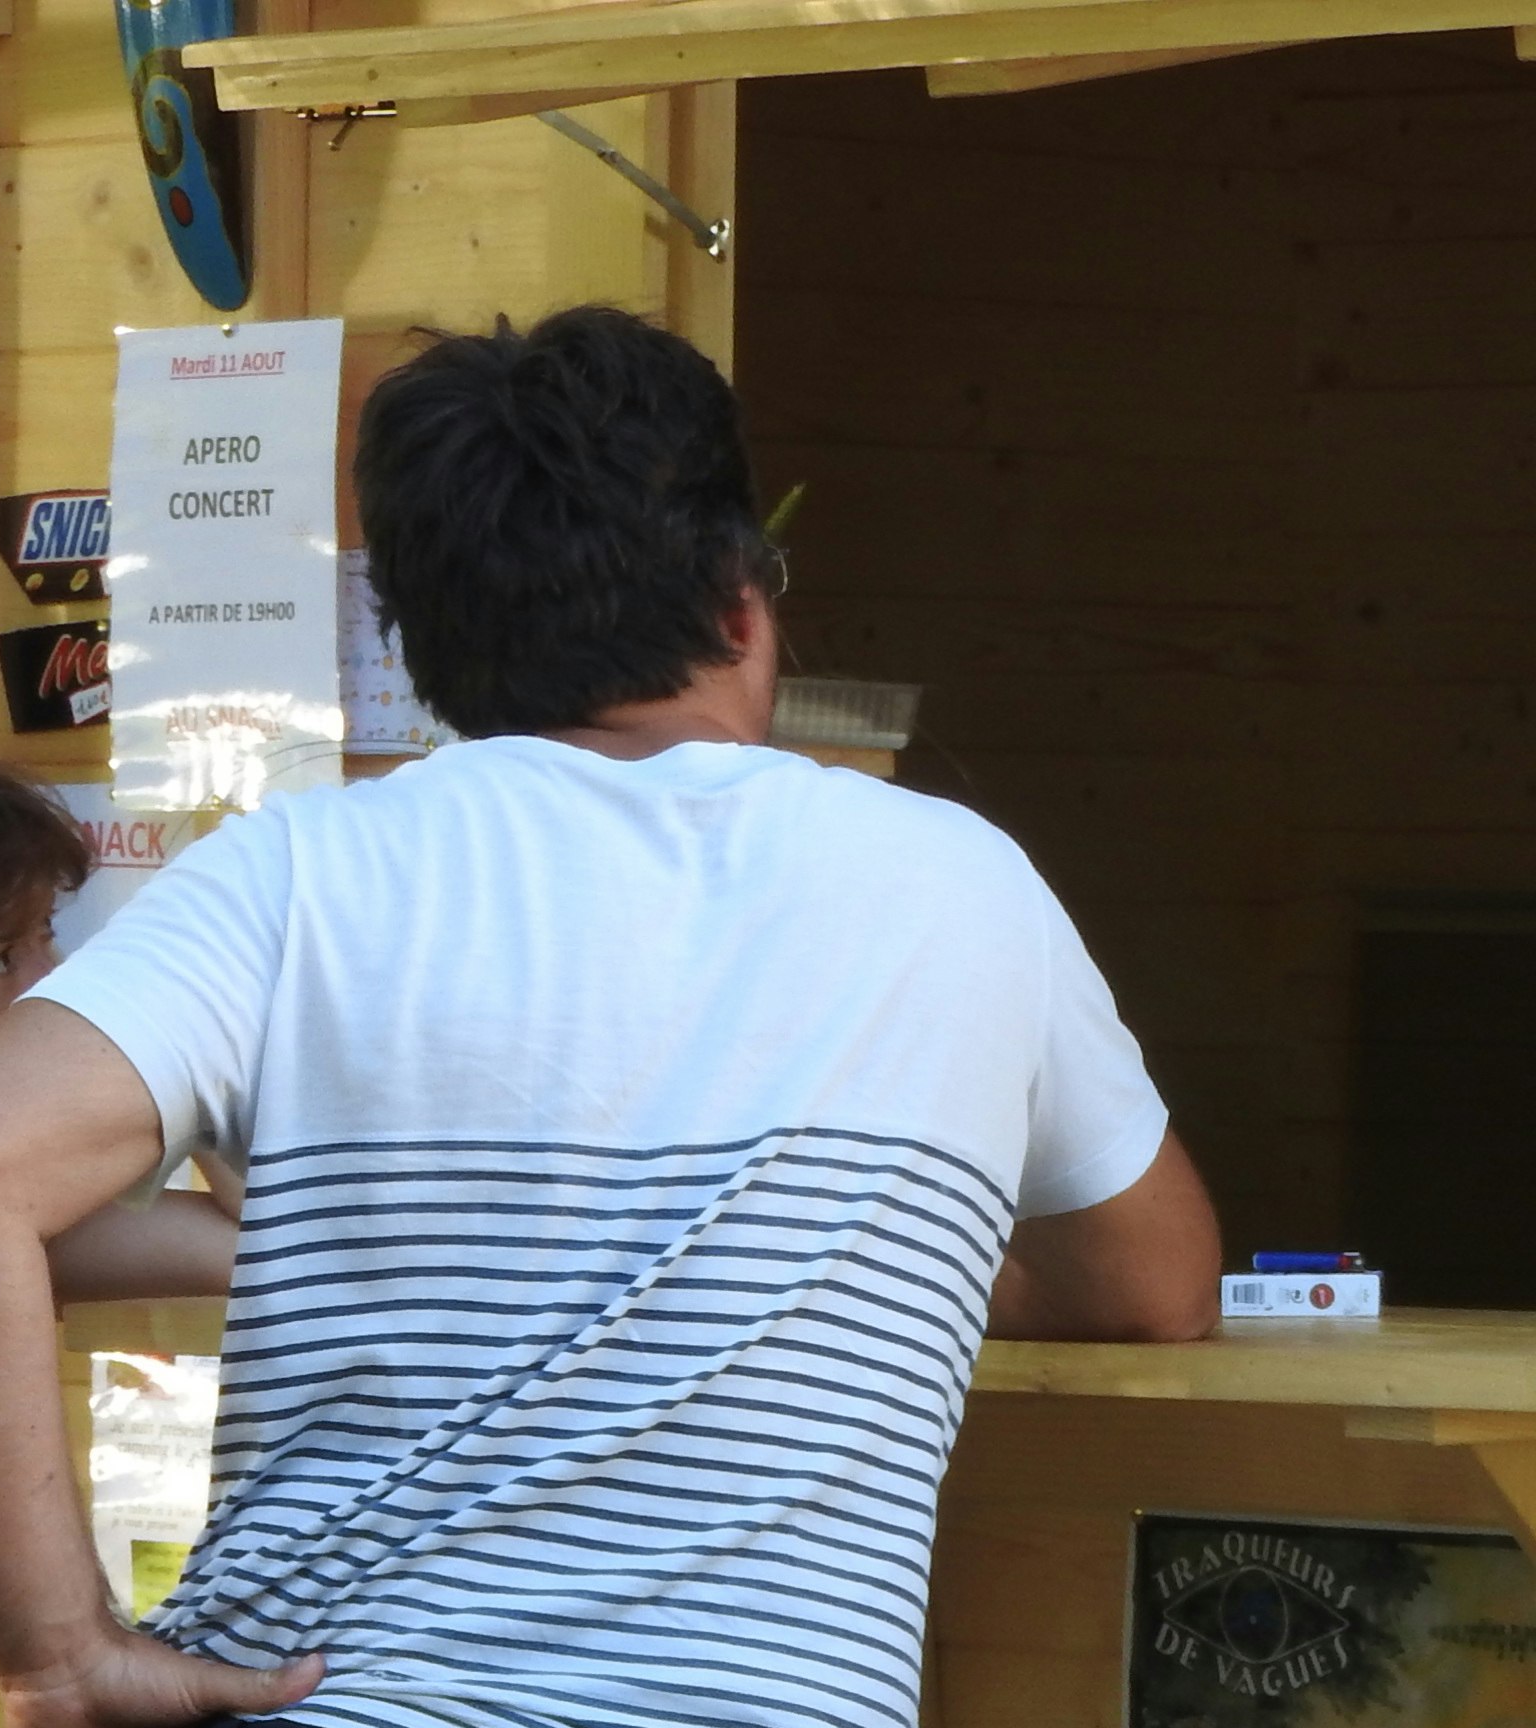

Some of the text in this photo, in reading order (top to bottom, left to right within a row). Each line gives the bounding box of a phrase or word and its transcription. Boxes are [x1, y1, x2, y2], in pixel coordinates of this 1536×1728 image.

[171, 351, 286, 376] Mardi 11 AOUT
[183, 435, 261, 465] APERO
[169, 489, 275, 519] CONCERT
[24, 499, 110, 561] SNIC
[149, 602, 295, 624] A PARTIR DE 19H00
[1153, 1531, 1356, 1609] TRAQUEURS
[1155, 1624, 1349, 1696] DE VAGUES
